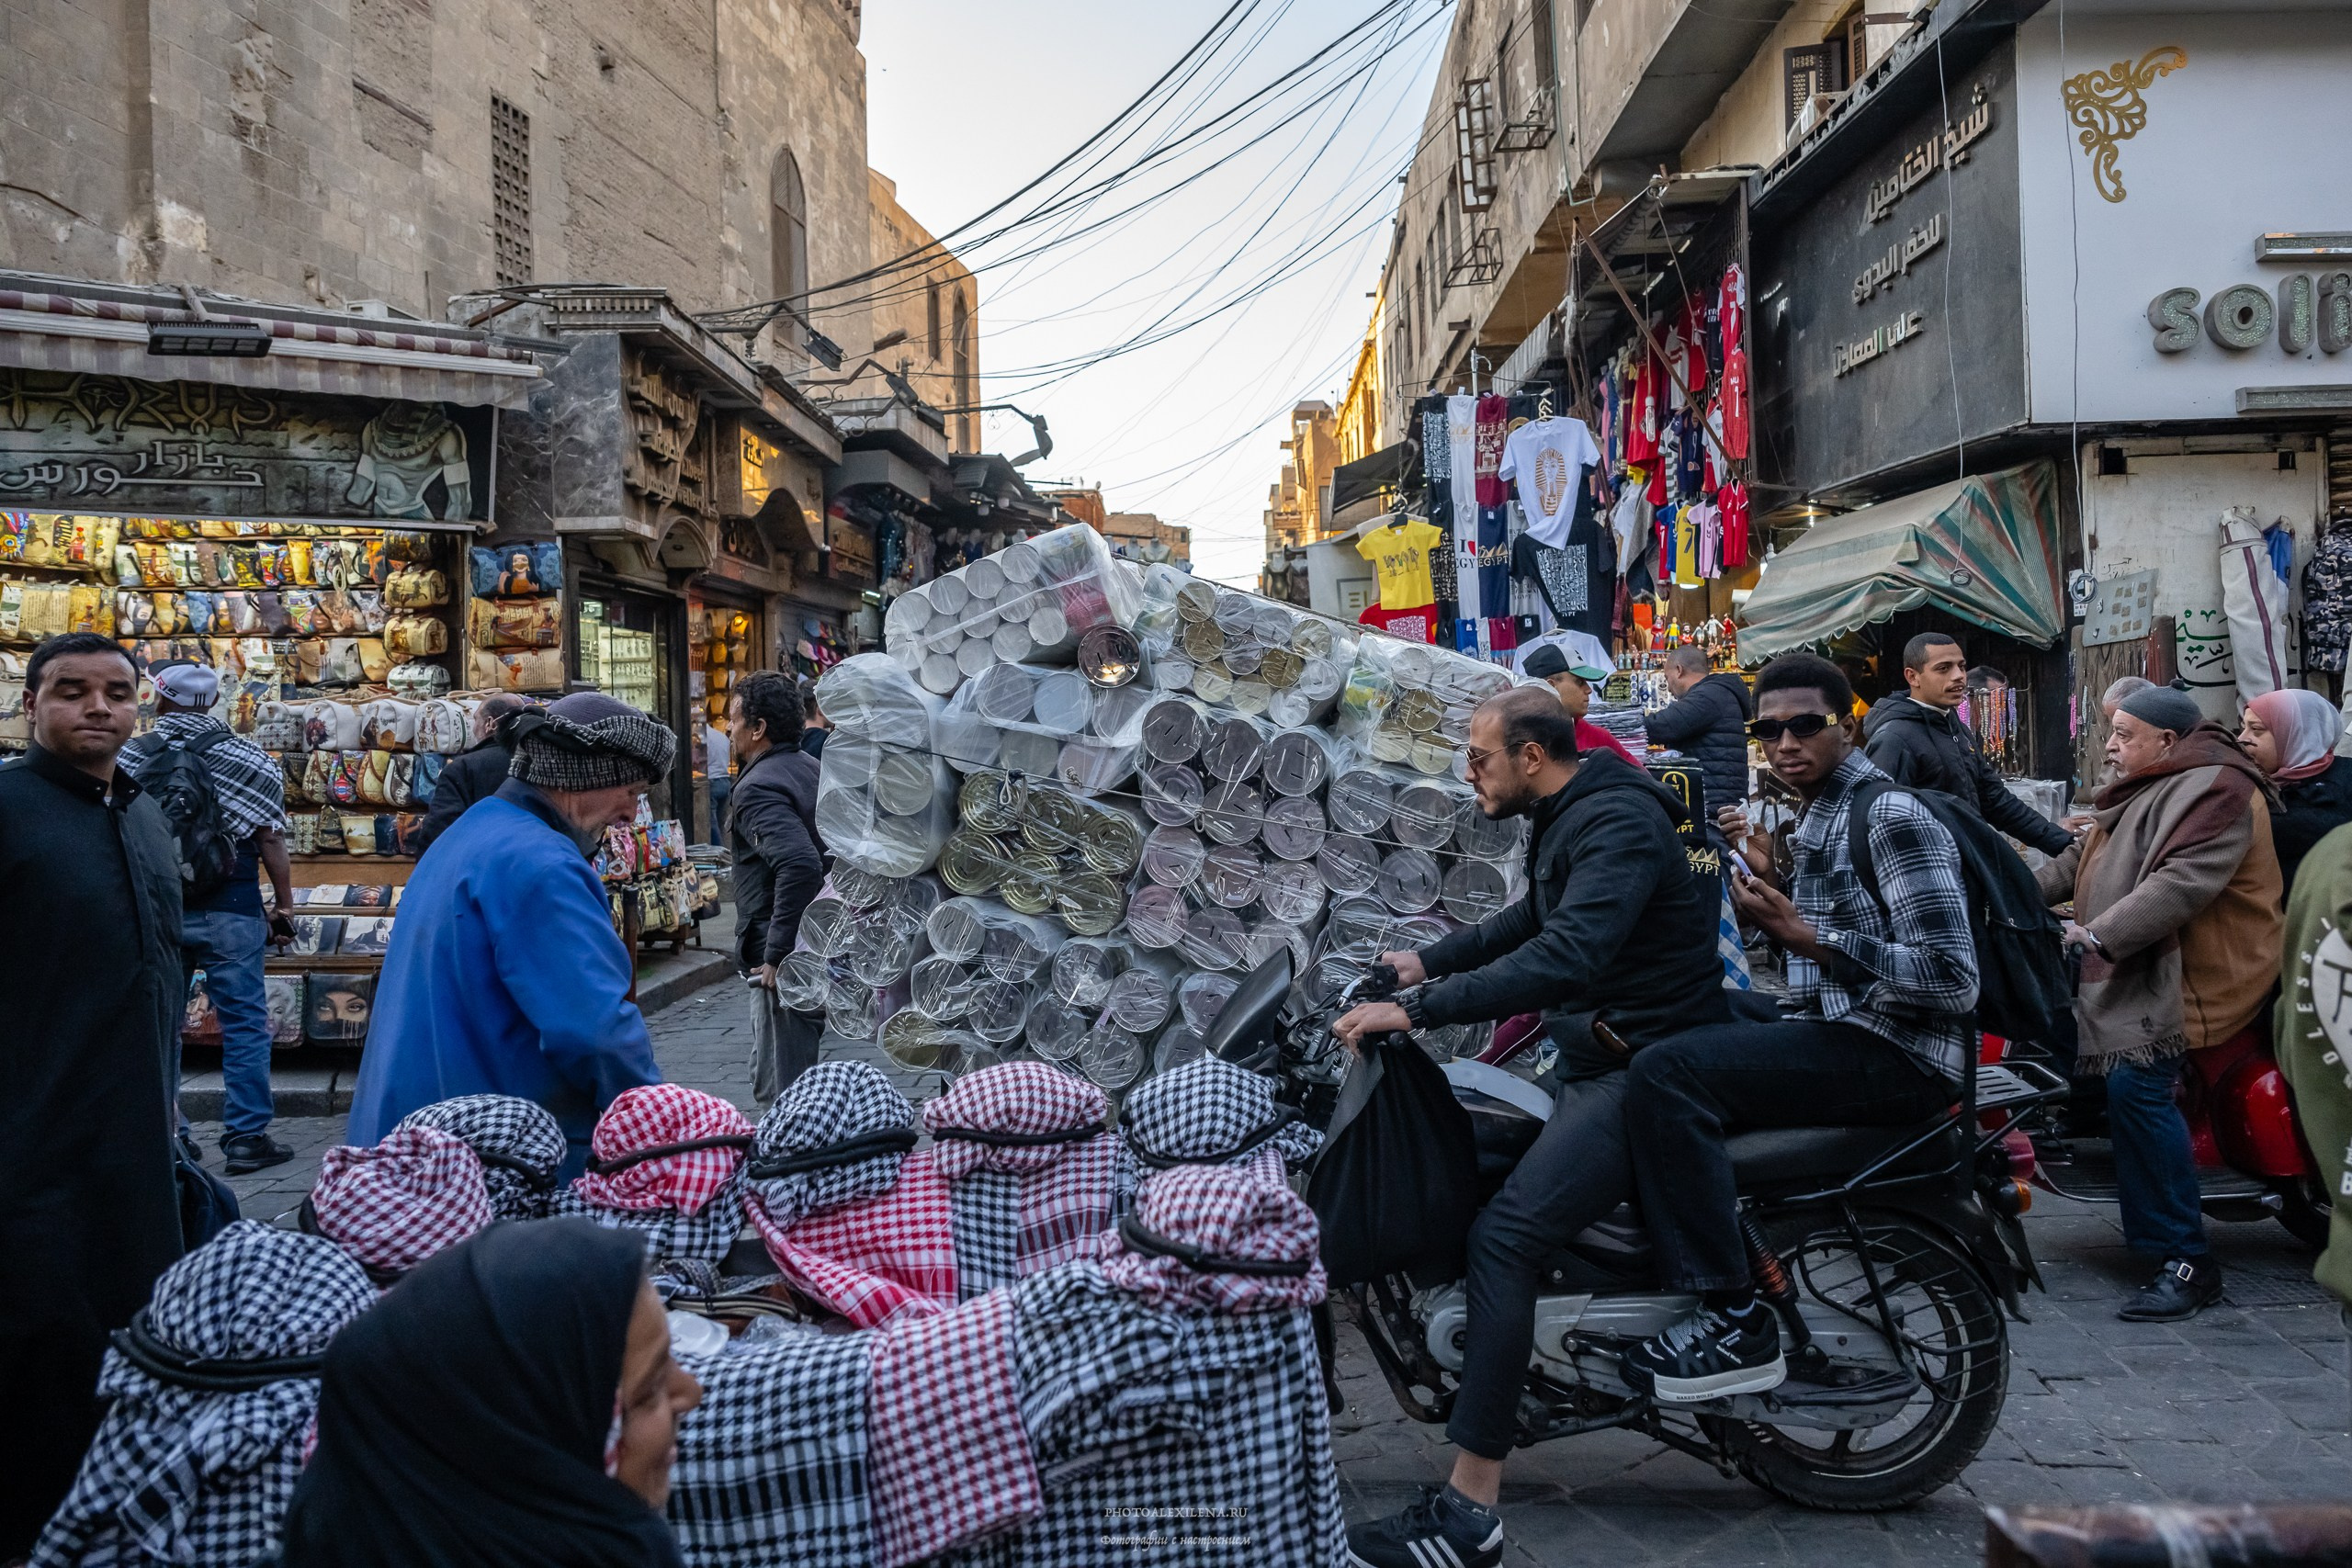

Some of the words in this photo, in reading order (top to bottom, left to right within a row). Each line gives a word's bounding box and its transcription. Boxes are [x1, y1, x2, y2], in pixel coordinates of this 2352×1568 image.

[1943, 83, 1989, 171] شيخ
[1886, 310, 1919, 348] على
[1832, 326, 1883, 378] المعادن
[133, 441, 226, 476] بازار
[0, 462, 264, 496] حورس
[1460, 539, 1466, 553] I
[1478, 556, 1509, 568] EGYPT
[1690, 861, 1720, 876] GYPT
